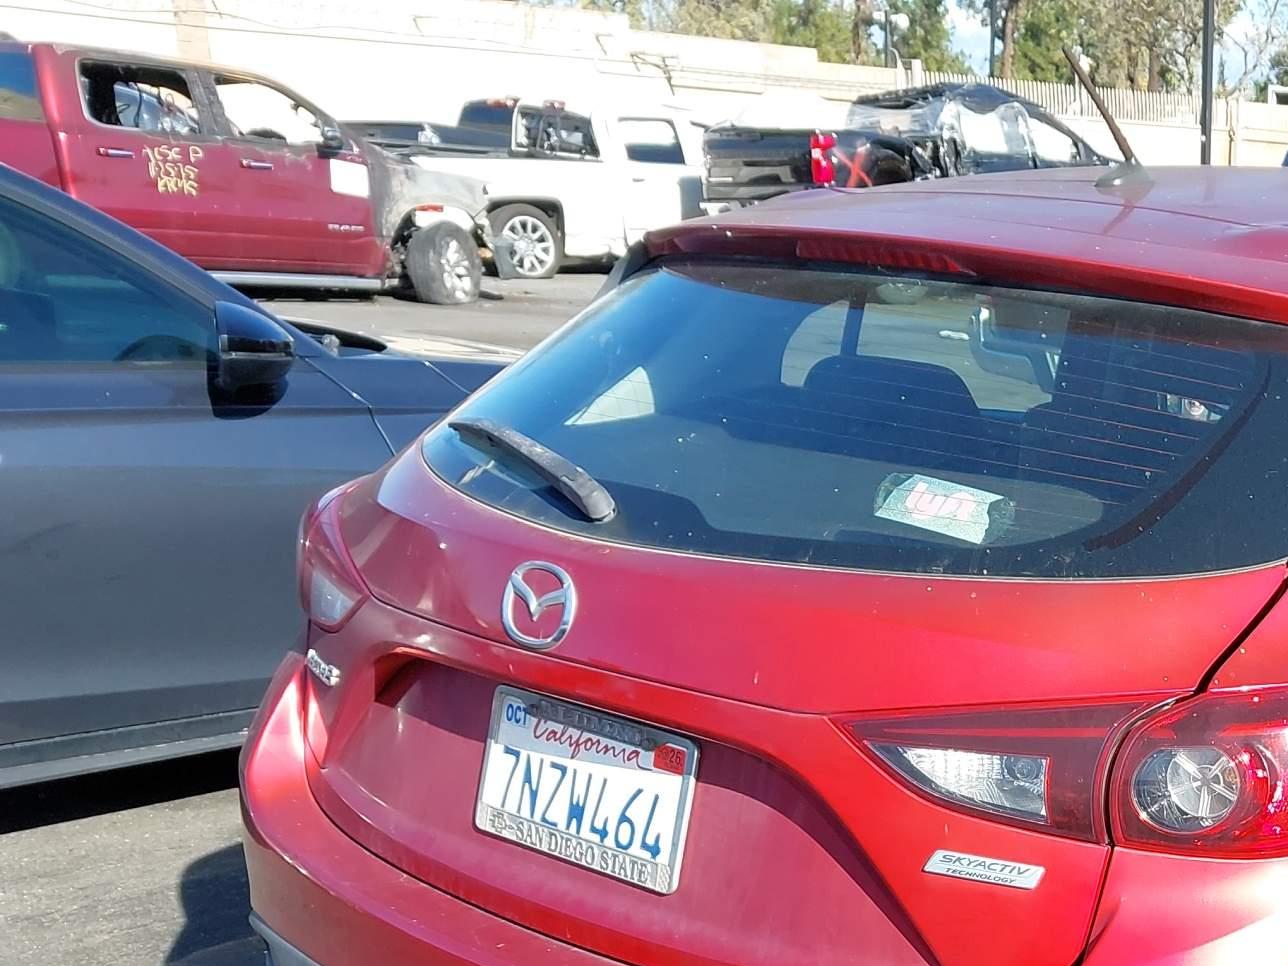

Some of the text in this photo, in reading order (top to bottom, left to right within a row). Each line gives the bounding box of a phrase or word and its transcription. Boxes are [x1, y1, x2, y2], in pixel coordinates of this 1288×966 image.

[506, 703, 528, 724] OCT
[532, 717, 652, 771] California
[501, 745, 662, 861] 7NZW464
[515, 816, 544, 850] SAN
[549, 831, 596, 867] DIEGO
[600, 850, 650, 884] STATE
[939, 854, 1031, 876] SKYACTIV
[944, 867, 1016, 884] TECHNOLOGY
